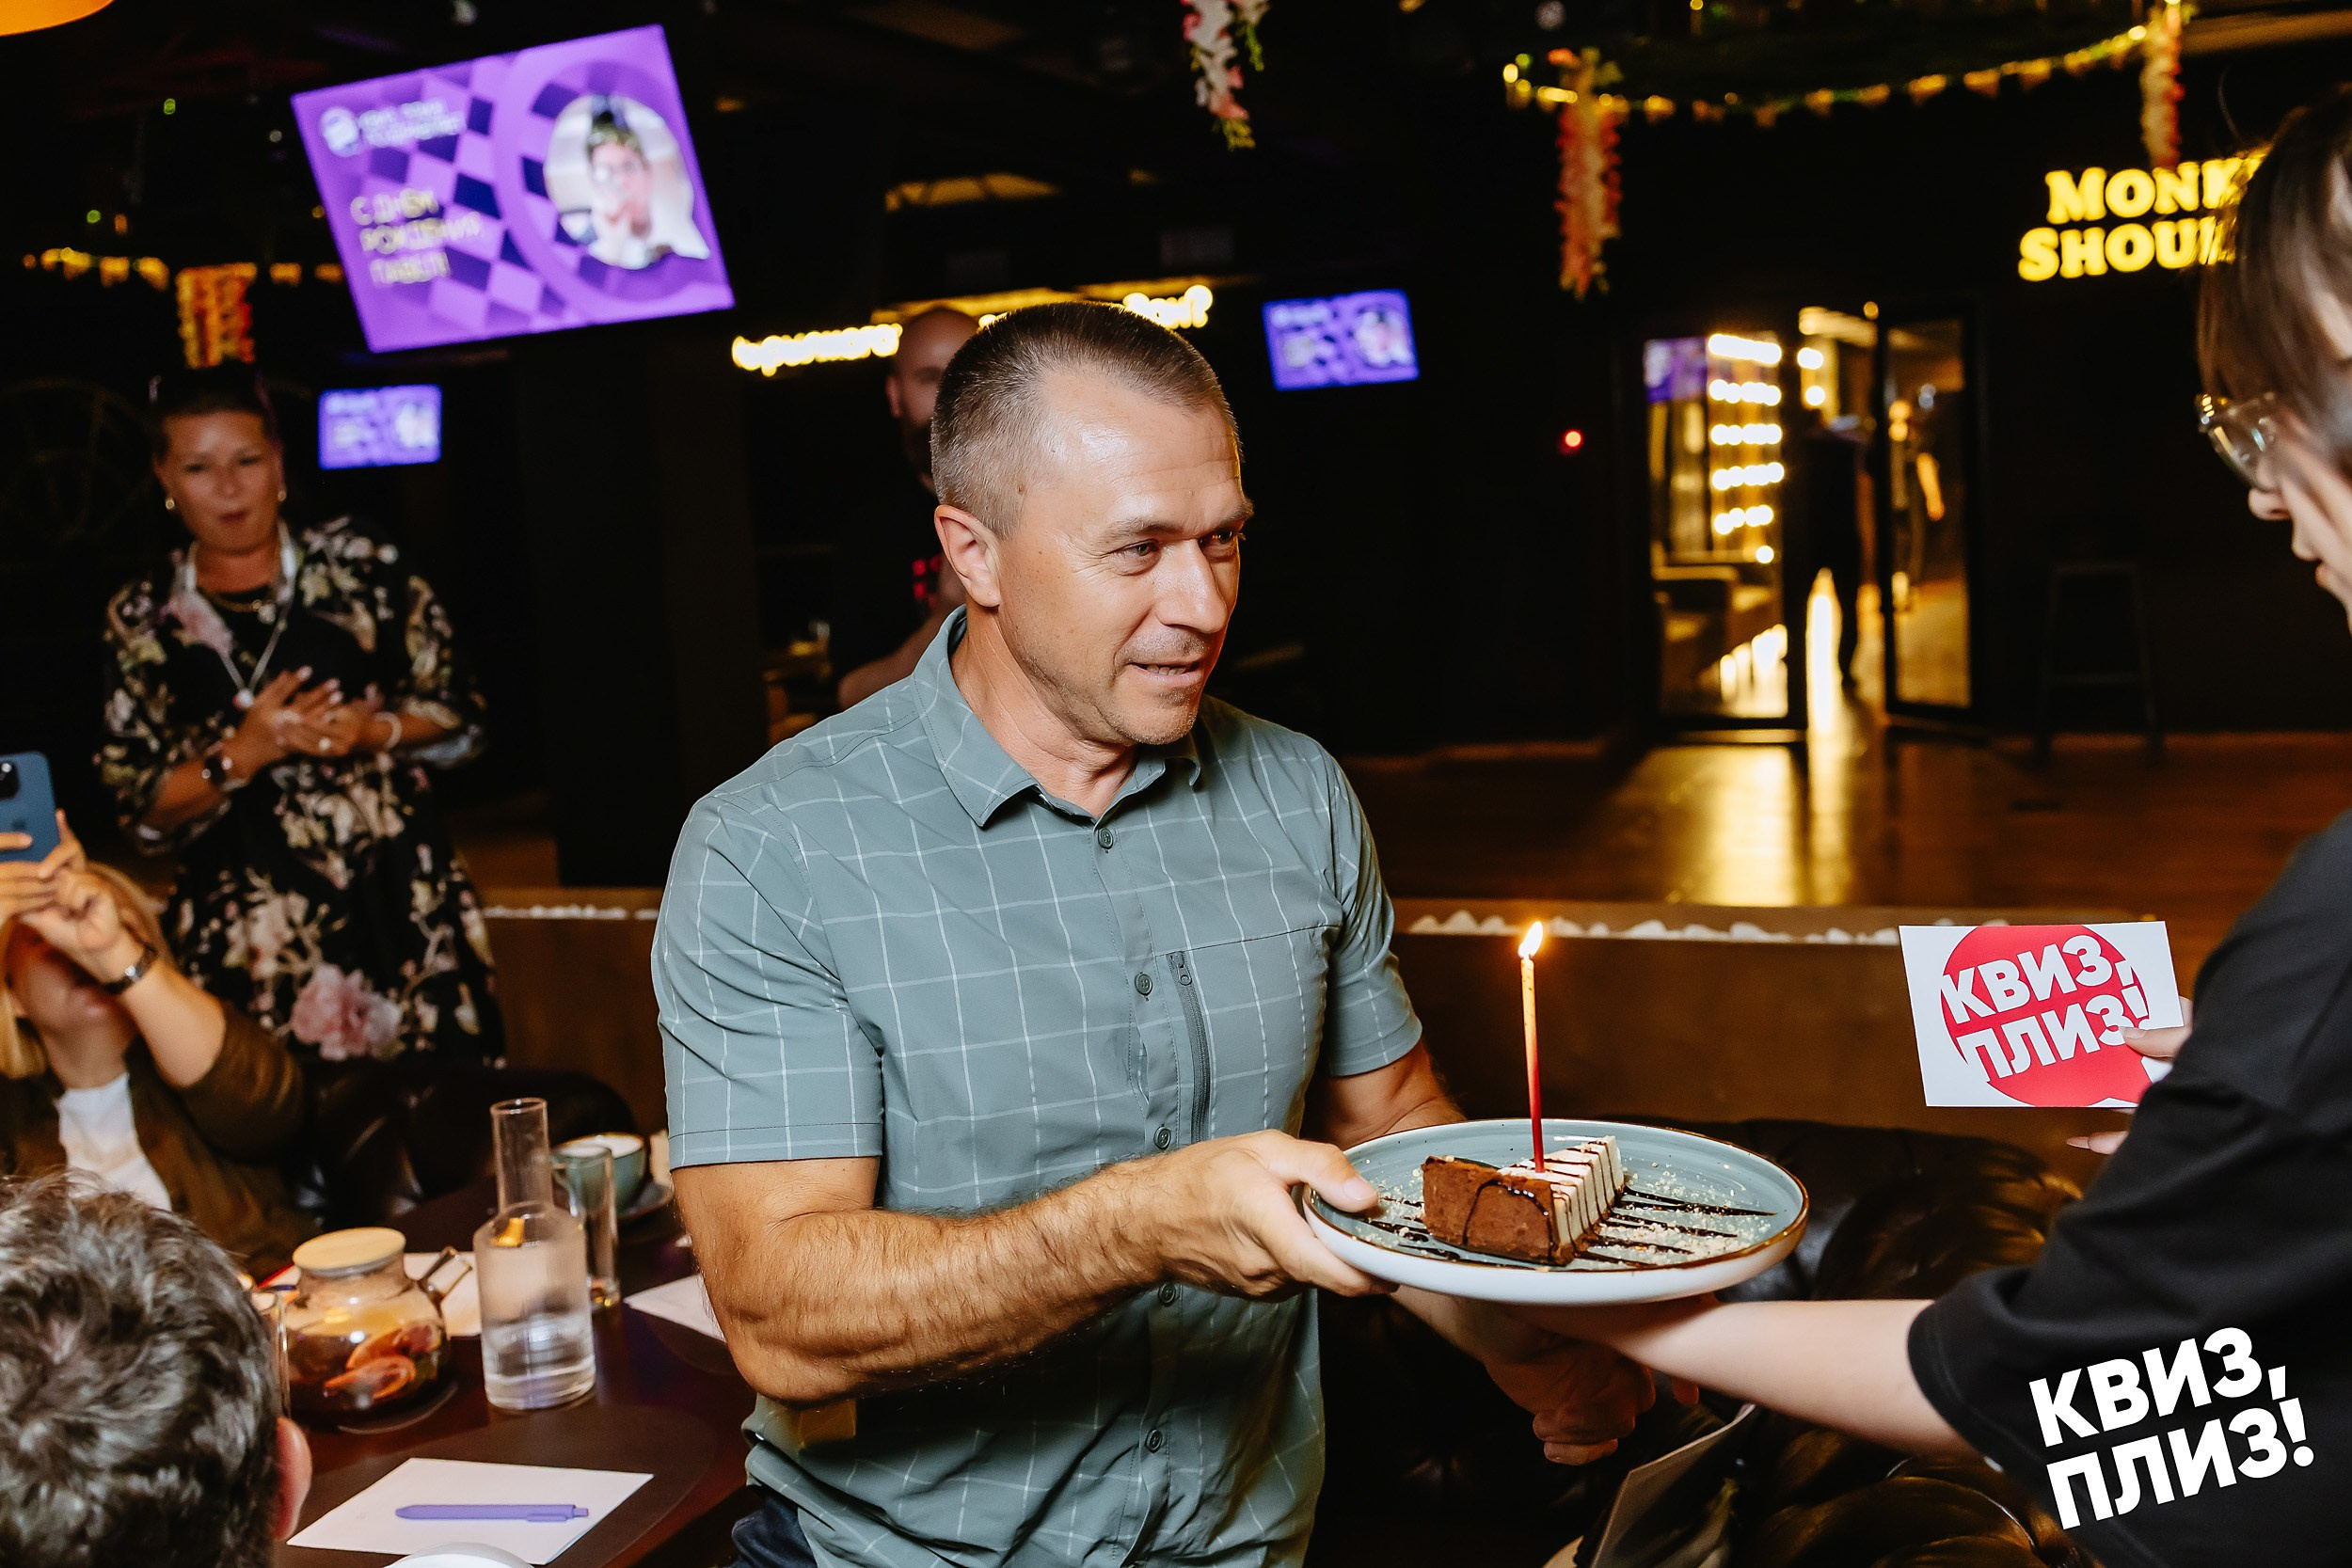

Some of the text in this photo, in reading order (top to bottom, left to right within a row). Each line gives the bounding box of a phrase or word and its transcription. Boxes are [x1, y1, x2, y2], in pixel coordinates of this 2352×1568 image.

[2018, 216, 2236, 281] SHOUL
[1941, 935, 2134, 1024] КВИЗ,
[1956, 985, 2151, 1082] ПЛИЗ!
[2029, 1327, 2286, 1448] КВИЗ,
